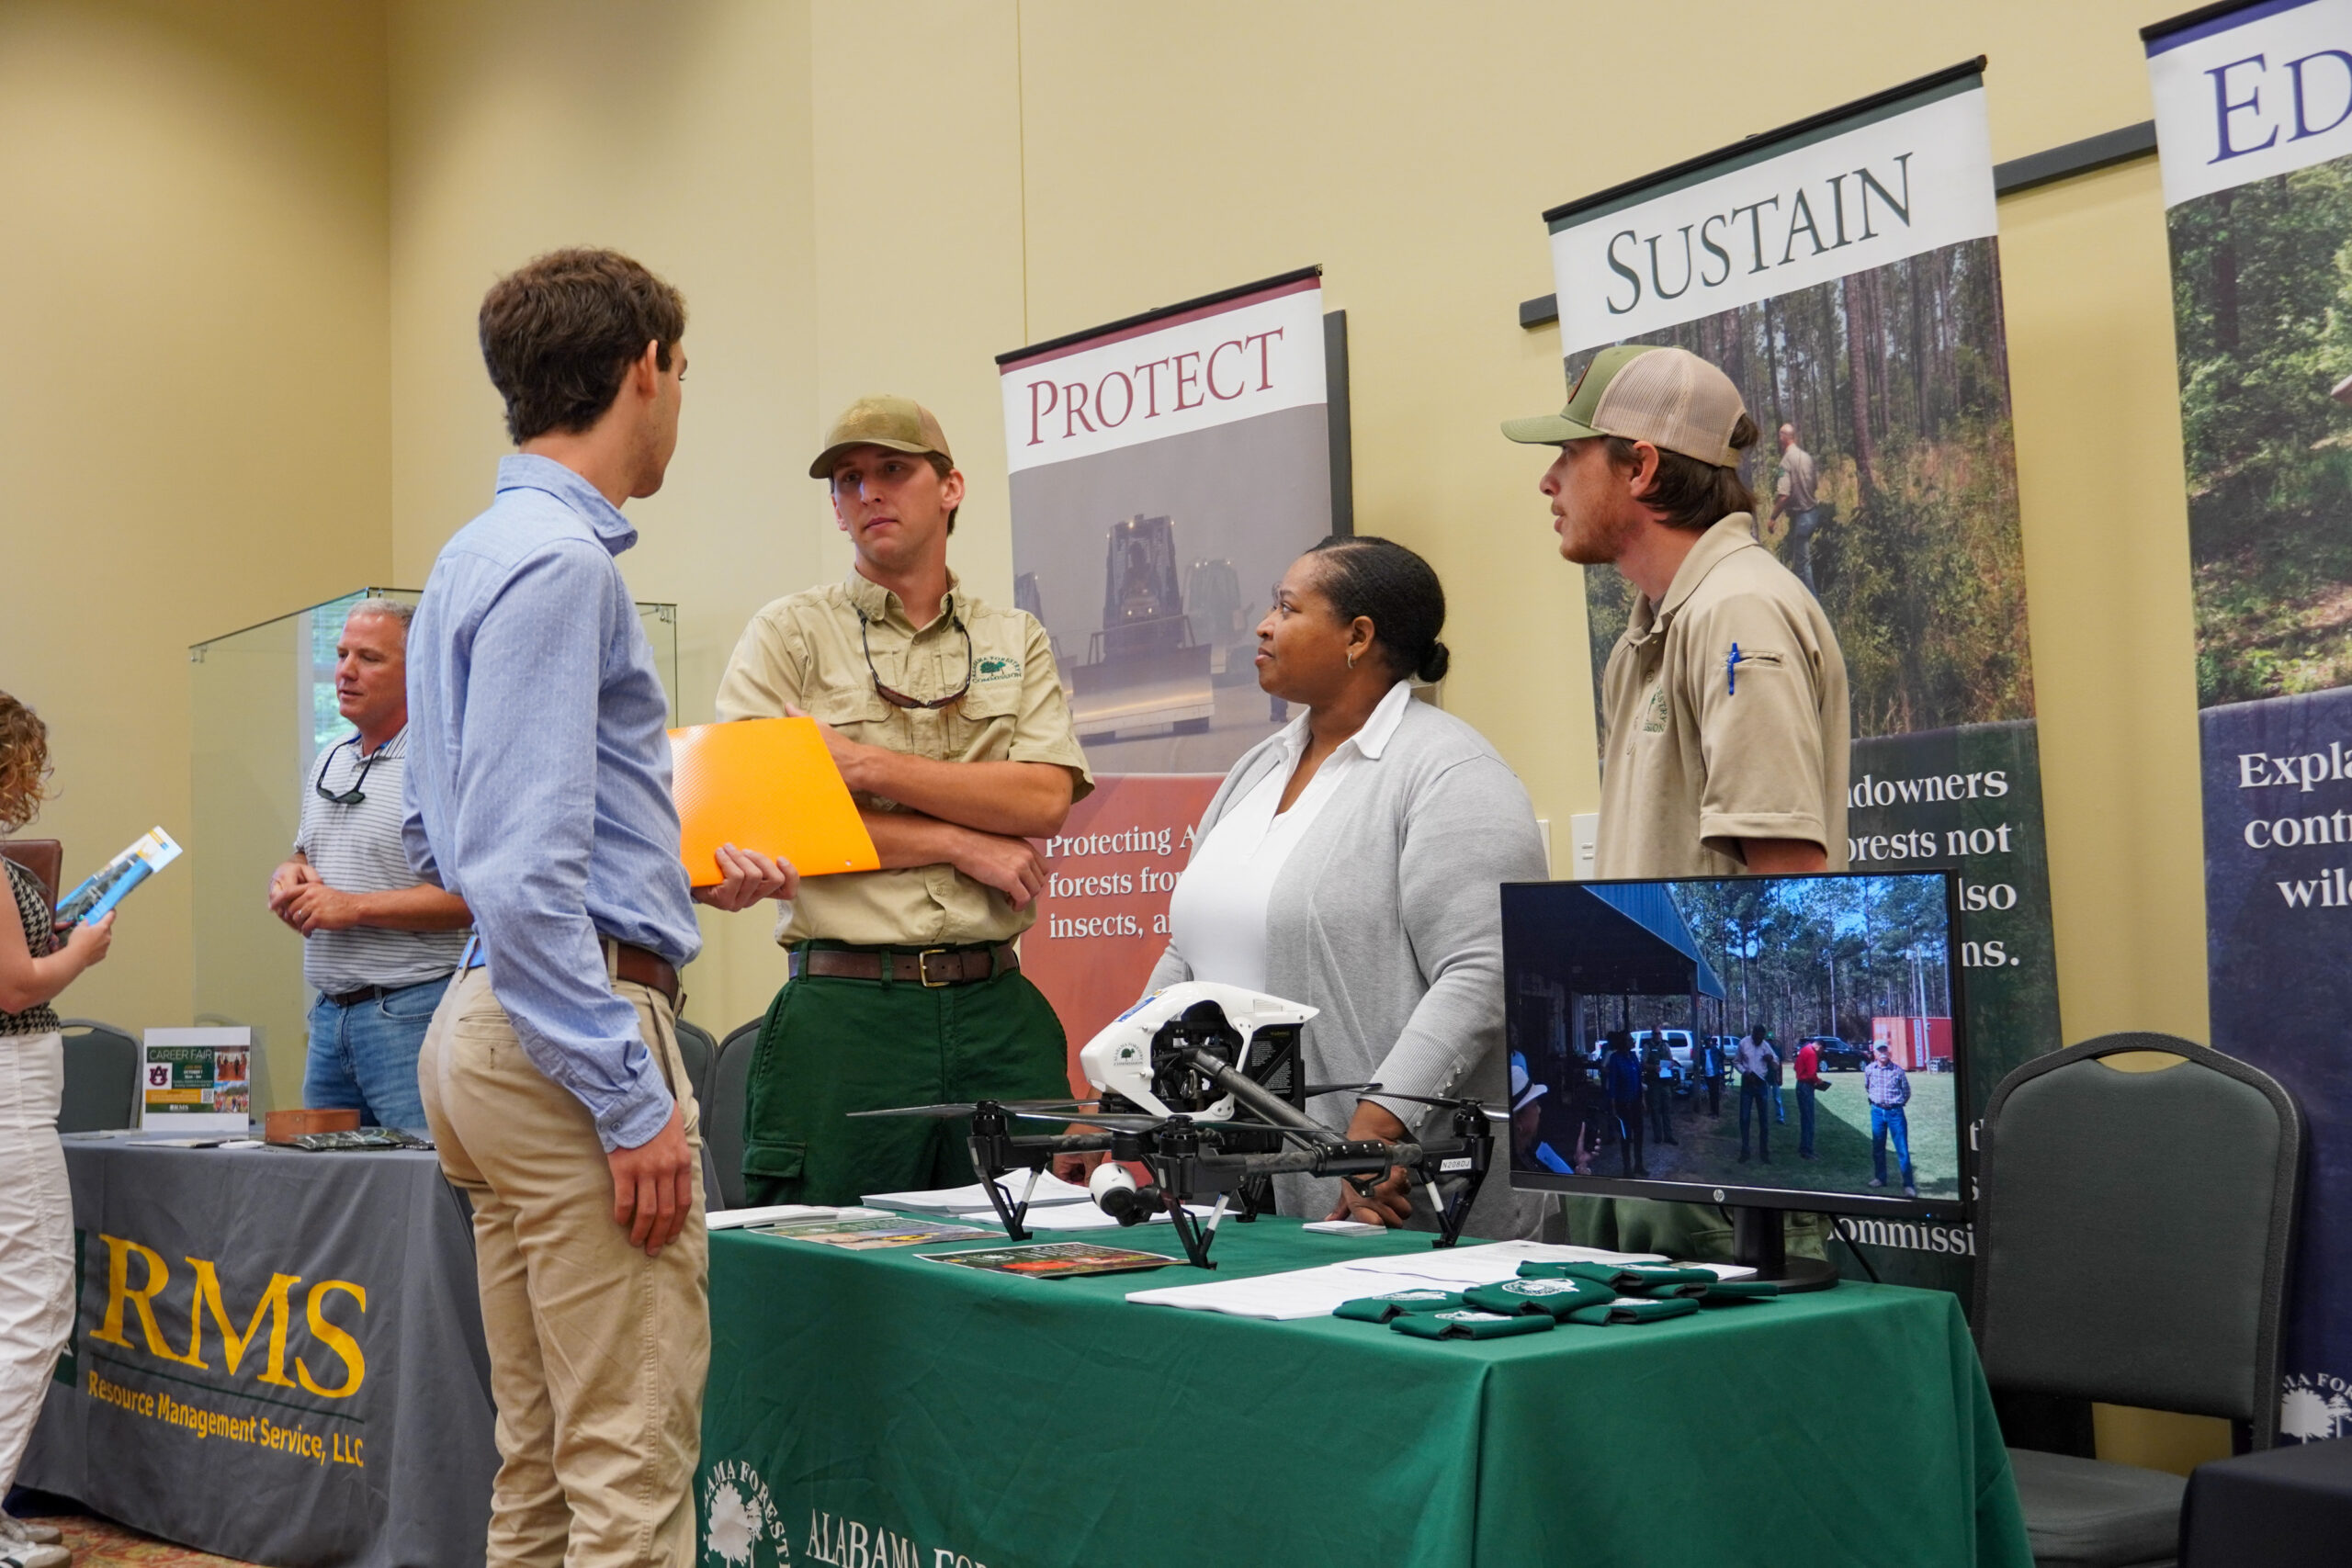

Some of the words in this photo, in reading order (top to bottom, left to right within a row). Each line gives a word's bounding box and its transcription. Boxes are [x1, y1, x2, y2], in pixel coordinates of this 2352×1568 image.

[2203, 50, 2352, 164] ED
[1607, 152, 1914, 315] SUSTAIN
[1026, 326, 1284, 446] PROTECT
[1046, 826, 1172, 858] Protecting
[1946, 822, 2012, 856] not
[1048, 873, 1133, 898] forests
[2276, 868, 2352, 908] wil
[1049, 912, 1145, 940] insects,
[149, 1049, 188, 1060] CAREER
[190, 1049, 212, 1059] FAIR
[90, 1234, 366, 1398] RMS
[88, 1370, 154, 1417] Resource
[157, 1393, 256, 1439] Management
[260, 1417, 326, 1467] Service,
[334, 1433, 365, 1467] LLC
